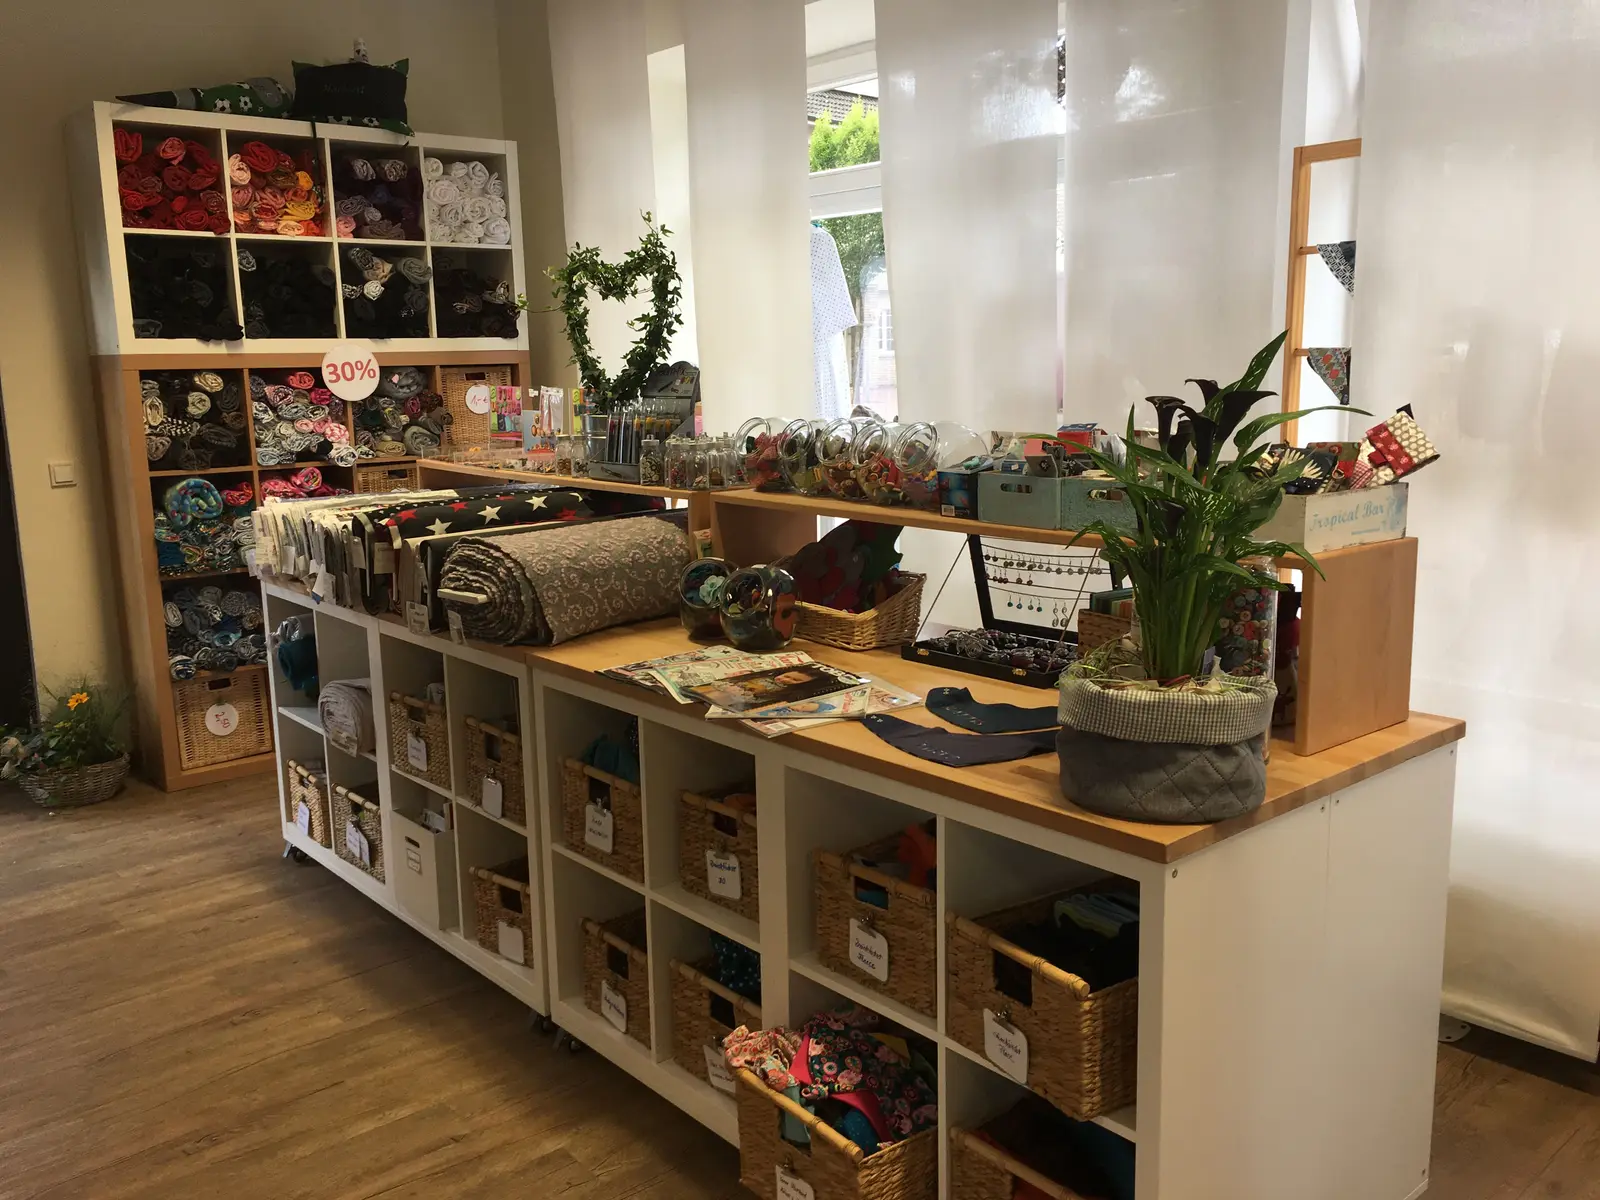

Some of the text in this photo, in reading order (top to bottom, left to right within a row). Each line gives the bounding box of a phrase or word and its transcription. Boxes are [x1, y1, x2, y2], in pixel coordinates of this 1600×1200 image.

[325, 358, 377, 384] 30%
[1309, 500, 1384, 532] Tropical Bar
